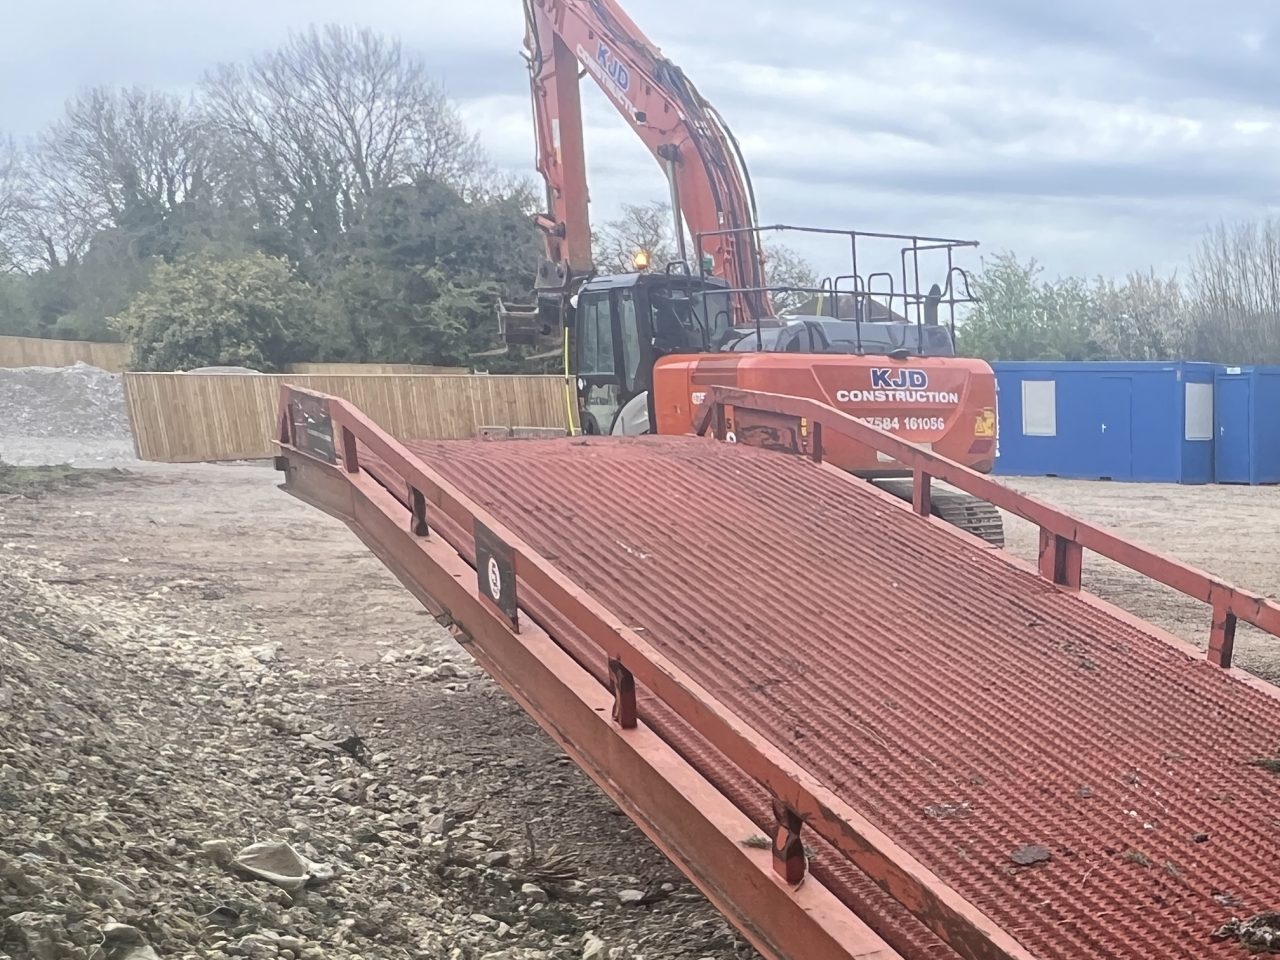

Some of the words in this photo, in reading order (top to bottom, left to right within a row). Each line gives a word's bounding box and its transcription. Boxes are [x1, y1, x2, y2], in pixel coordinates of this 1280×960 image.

[596, 39, 629, 93] KJD
[870, 367, 928, 390] KJD
[836, 390, 959, 404] CONSTRUCTION
[904, 417, 945, 430] 161056
